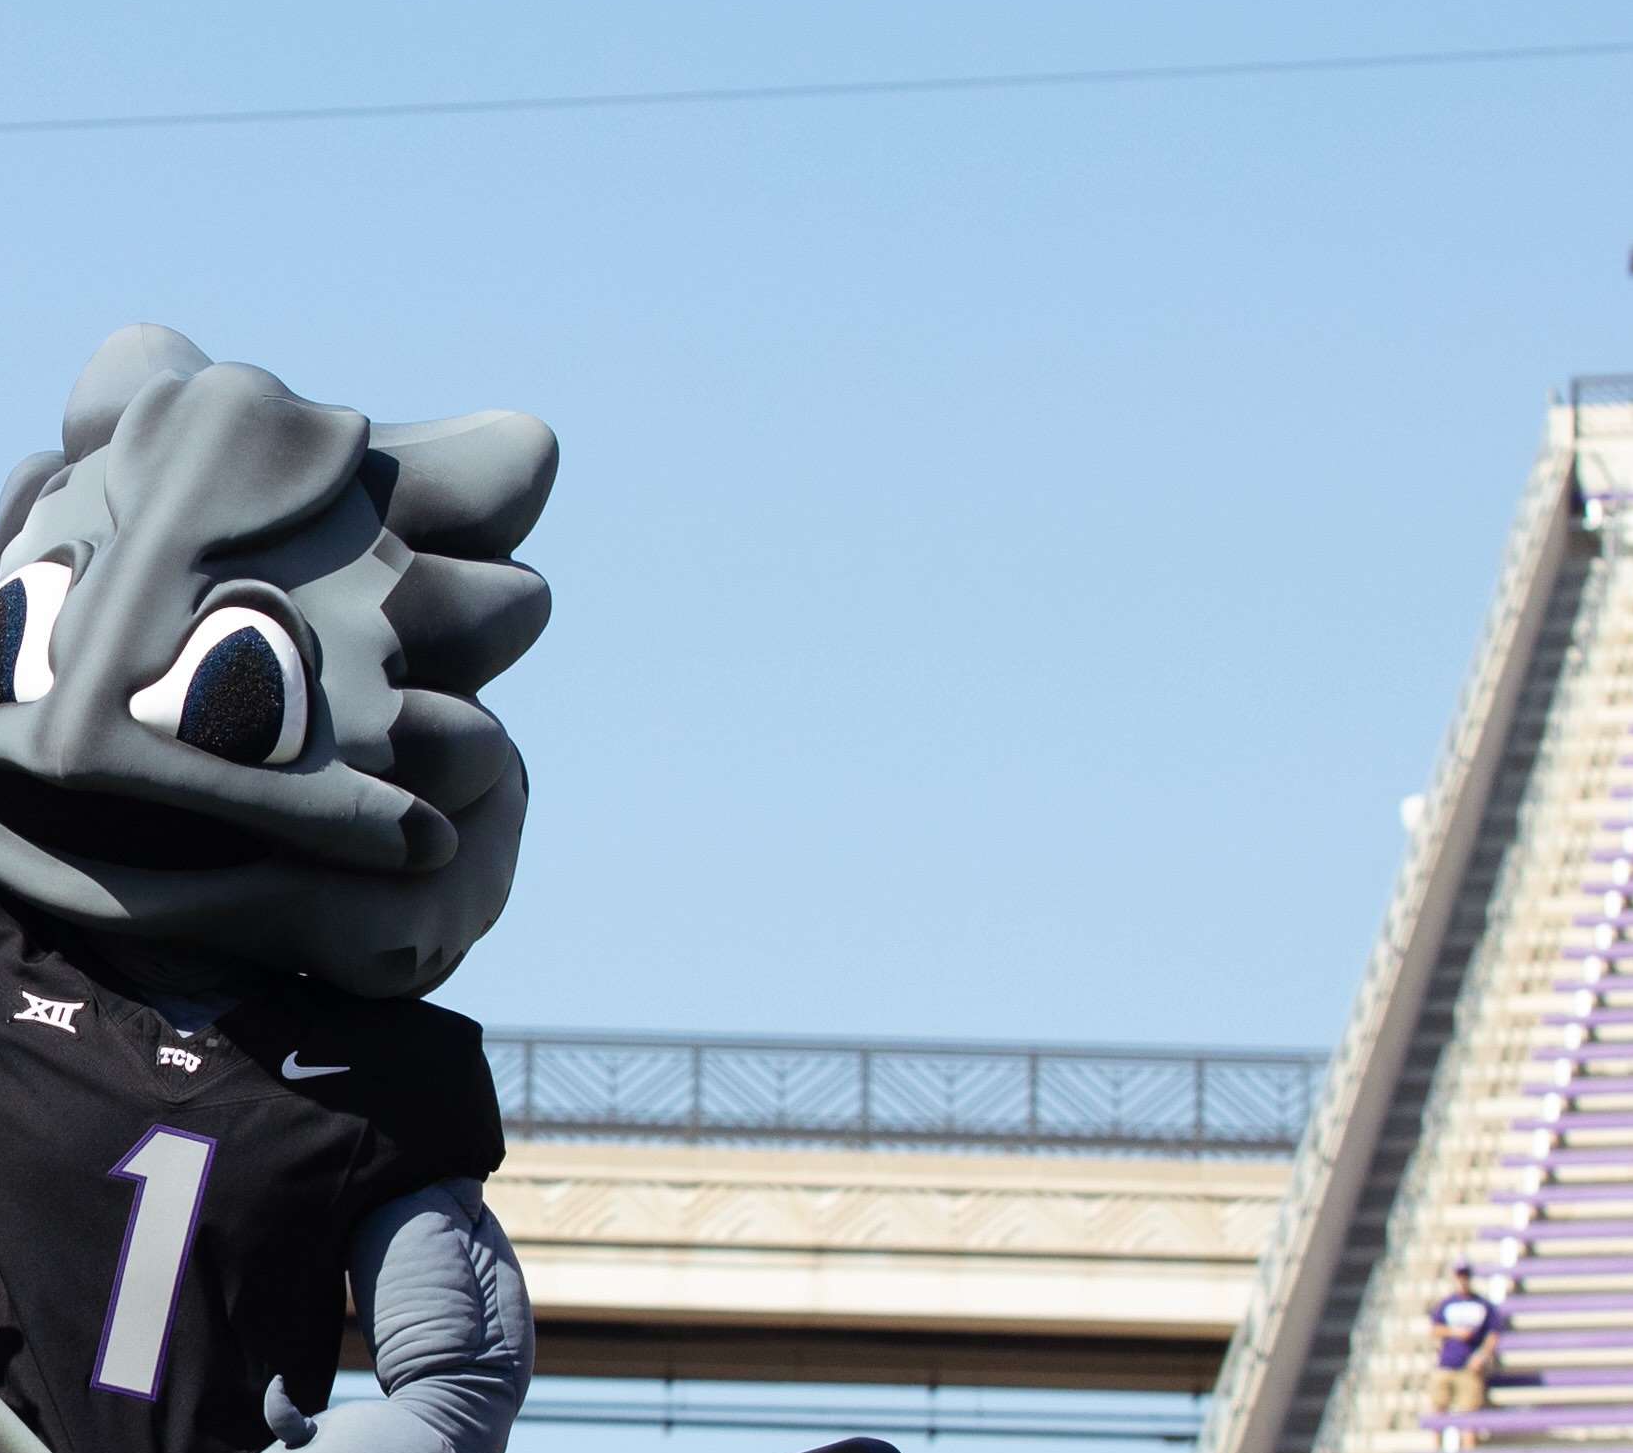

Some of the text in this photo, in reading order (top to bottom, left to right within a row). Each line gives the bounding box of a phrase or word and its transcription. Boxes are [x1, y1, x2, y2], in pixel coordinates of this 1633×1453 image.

[13, 990, 84, 1034] XII
[158, 1046, 204, 1074] TCU
[89, 1123, 219, 1402] 1
